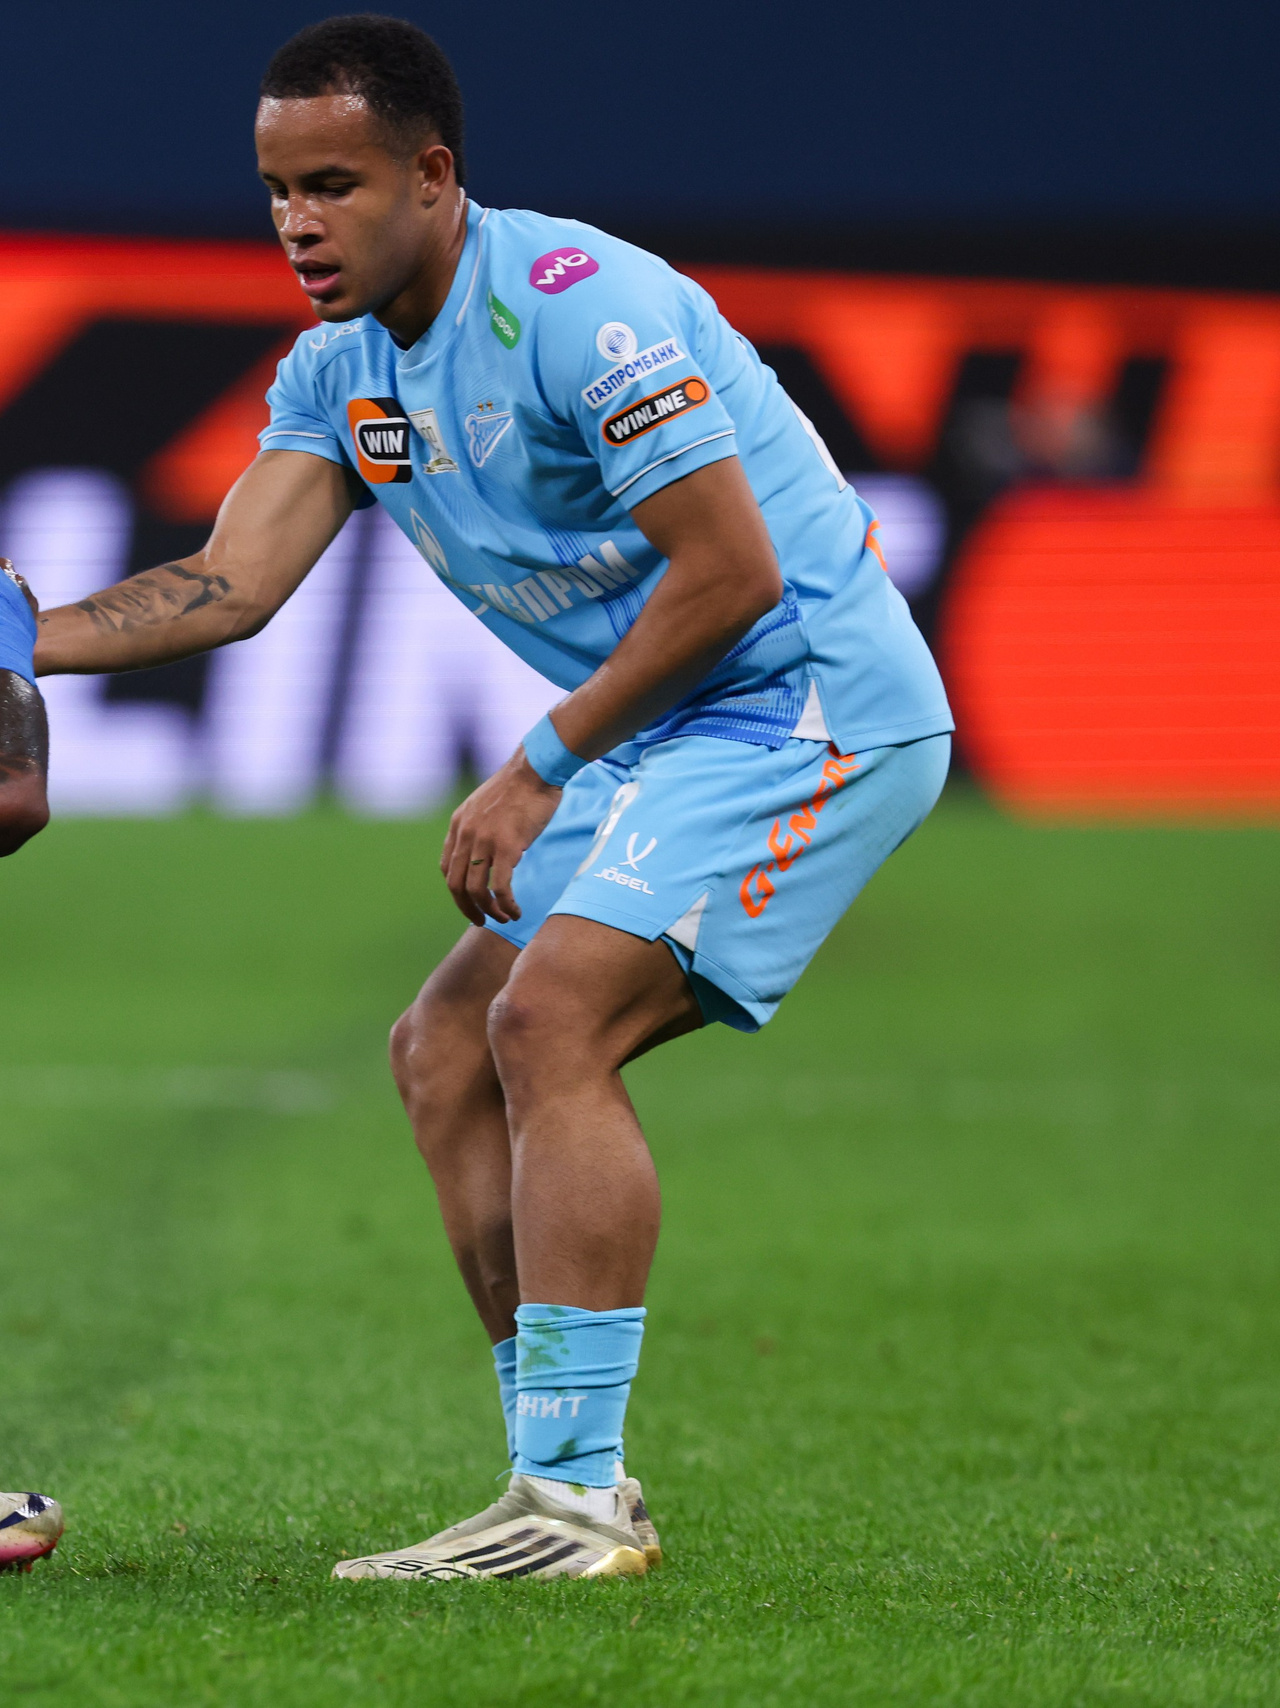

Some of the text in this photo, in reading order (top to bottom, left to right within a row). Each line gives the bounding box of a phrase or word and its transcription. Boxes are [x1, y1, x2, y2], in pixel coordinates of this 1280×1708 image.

[586, 343, 678, 404] ГАЗПРОМБАНК
[609, 389, 687, 440] WINLINE
[362, 429, 404, 454] WIN
